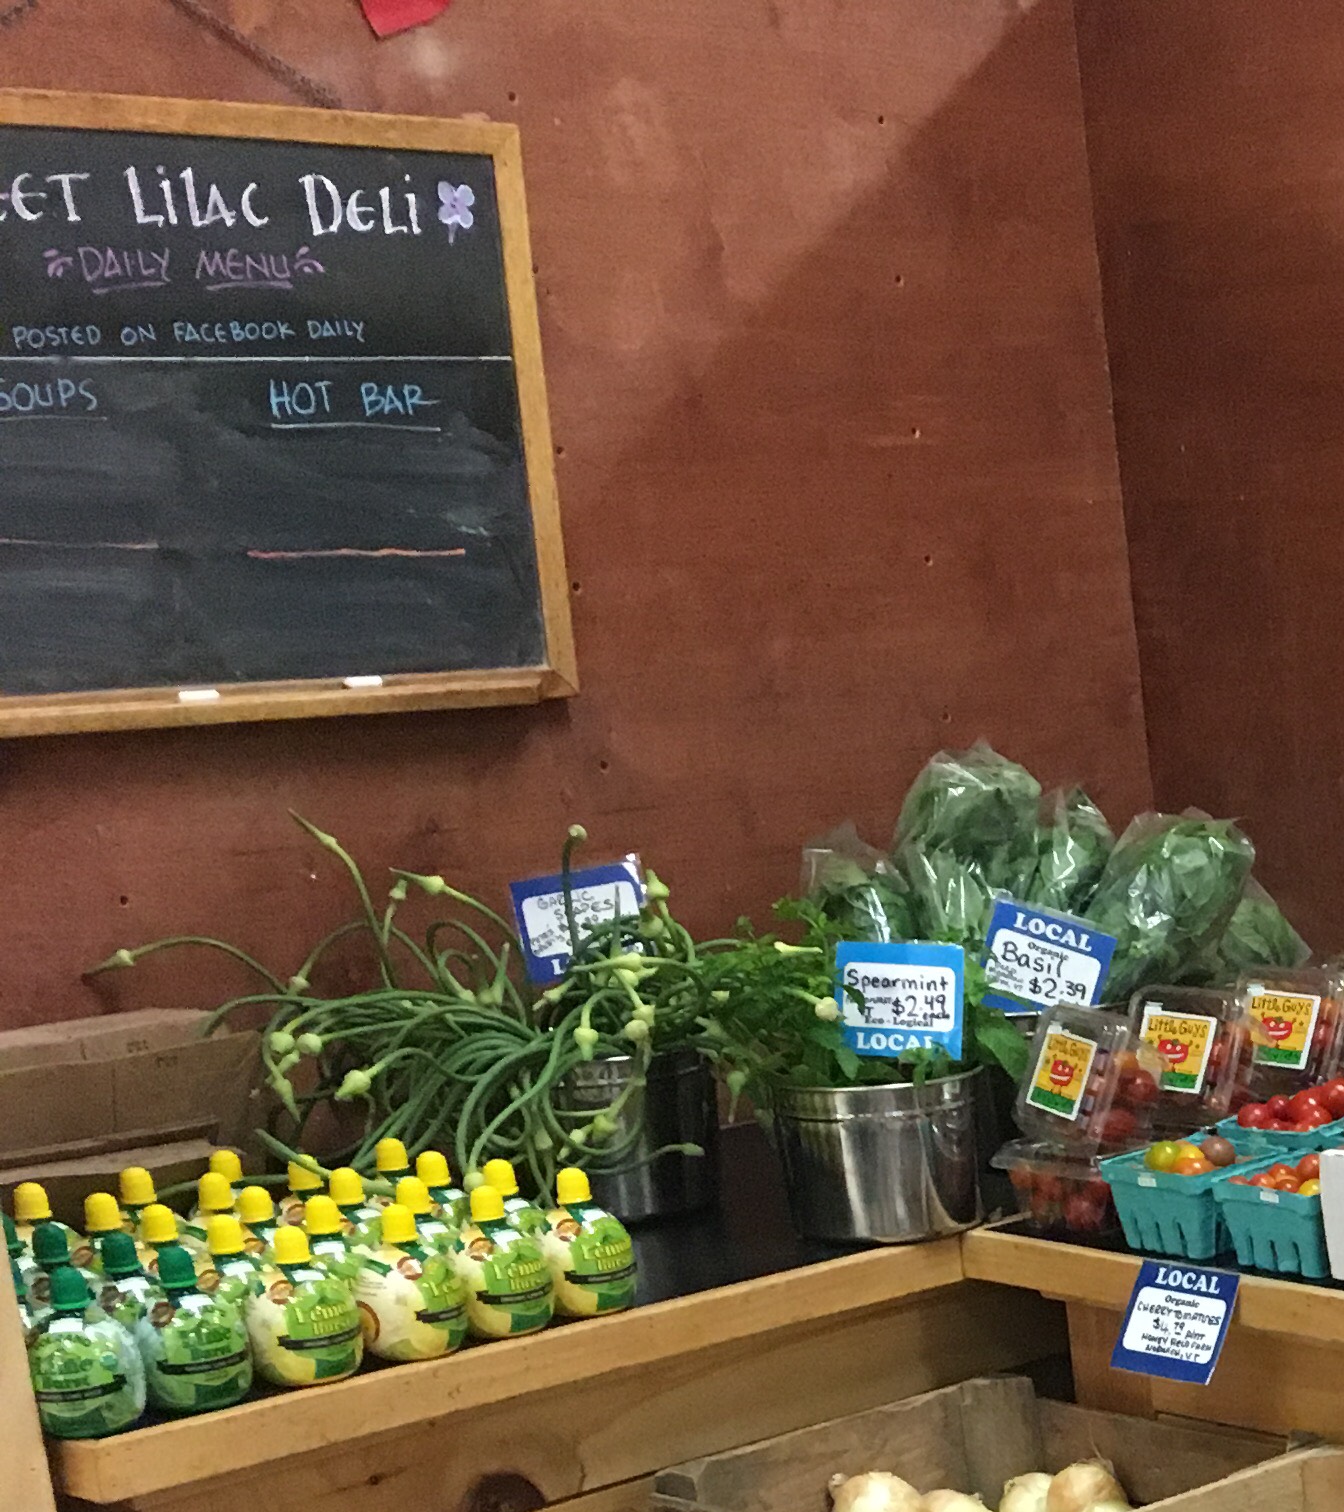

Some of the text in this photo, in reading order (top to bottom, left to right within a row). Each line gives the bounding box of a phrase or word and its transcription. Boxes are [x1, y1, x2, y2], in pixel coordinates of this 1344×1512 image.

[0, 172, 91, 222] ET
[78, 246, 292, 283] DAILY MENU
[12, 319, 366, 350] POSTED ON FACEBOOK DAILY
[269, 379, 442, 418] HOT BAR
[1013, 911, 1092, 952] LOCAL
[1001, 941, 1065, 978] Basil
[846, 968, 949, 993] Spearmint
[1029, 976, 1086, 1000] $2.39
[892, 994, 946, 1017] $2.49
[1155, 1267, 1220, 1294] LOCAL
[1165, 1294, 1200, 1308] Organic
